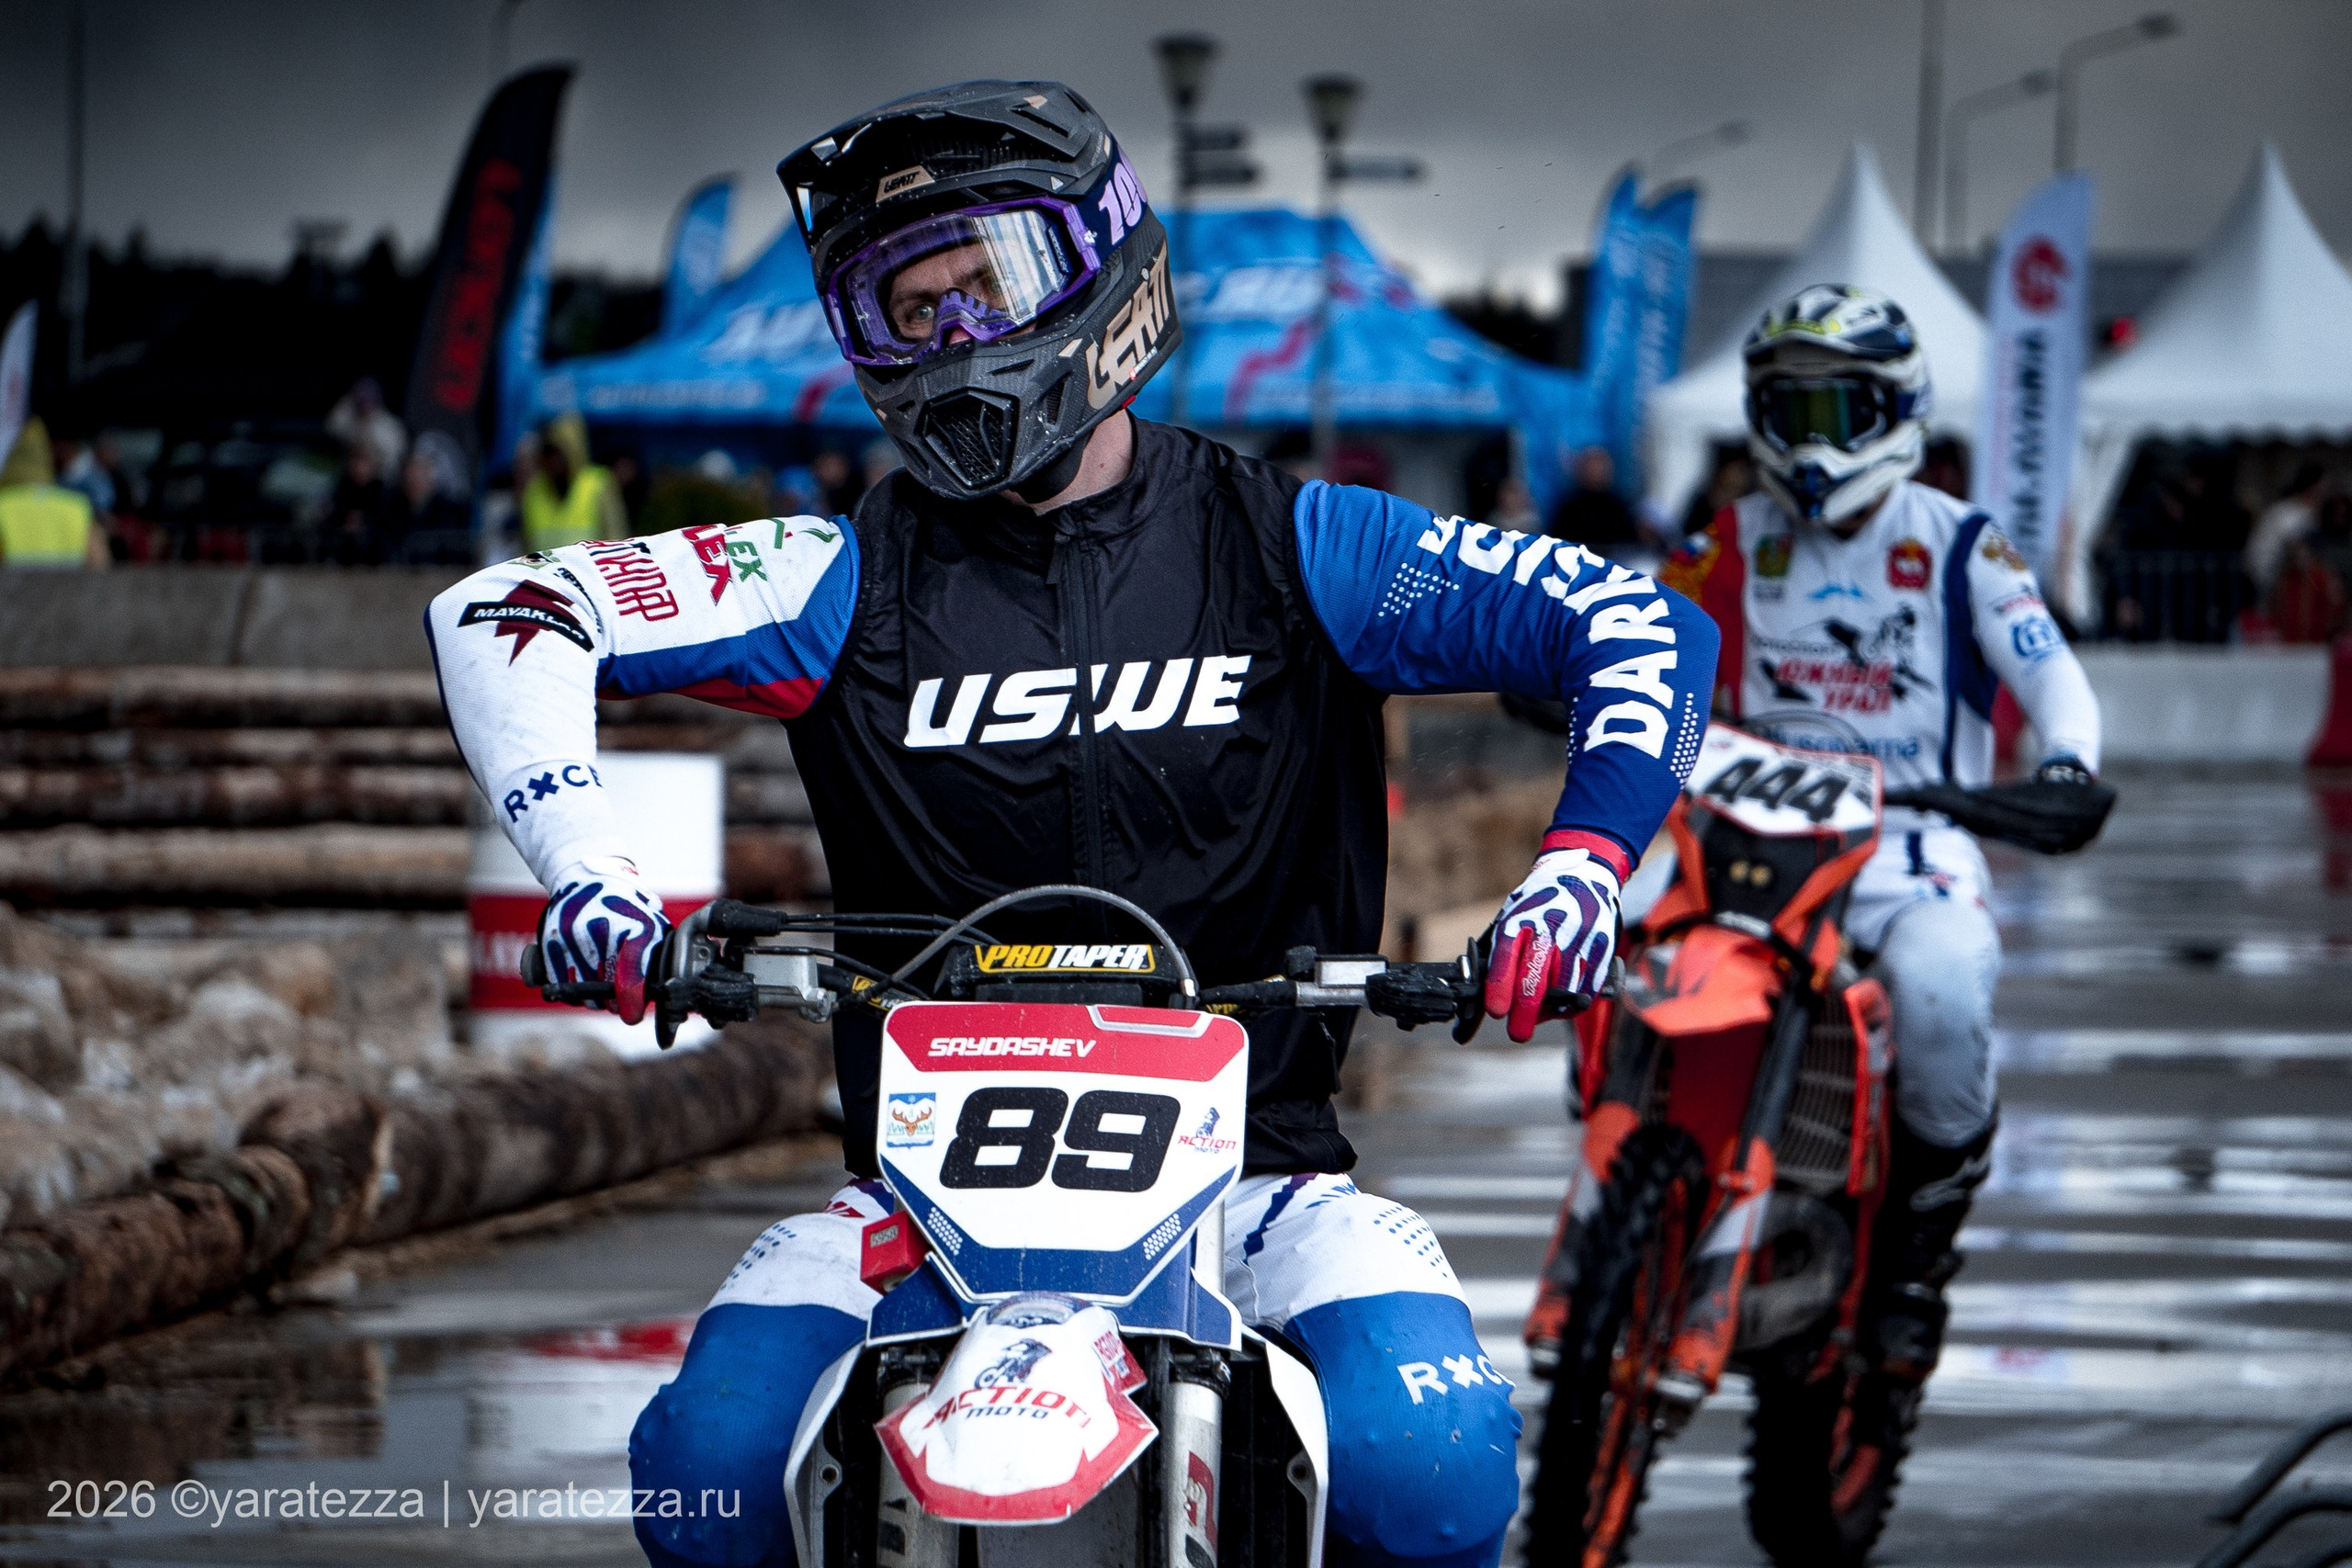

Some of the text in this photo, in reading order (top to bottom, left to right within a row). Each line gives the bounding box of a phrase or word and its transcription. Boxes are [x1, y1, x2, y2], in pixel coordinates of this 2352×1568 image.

[904, 655, 1252, 749] USWE
[1703, 758, 1850, 823] 444
[927, 1036, 1097, 1059] SAYDASHEV
[939, 1087, 1182, 1193] 89
